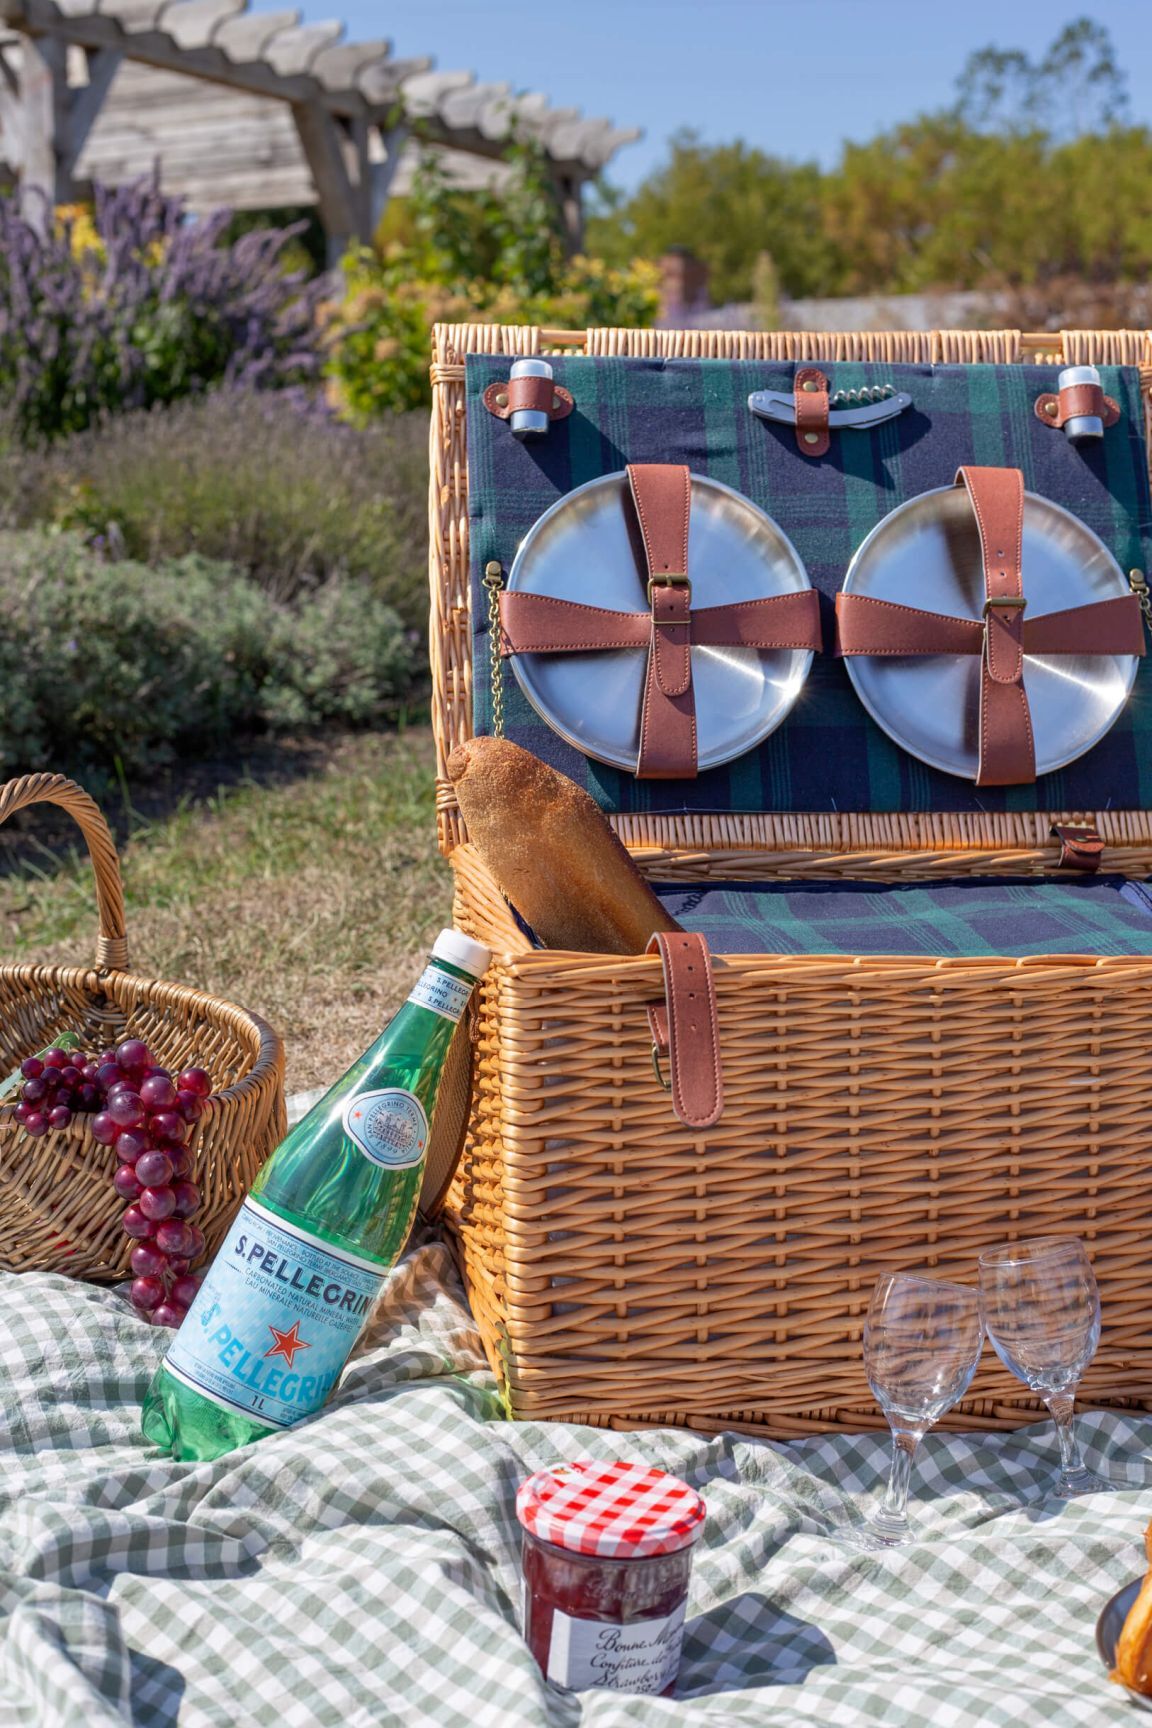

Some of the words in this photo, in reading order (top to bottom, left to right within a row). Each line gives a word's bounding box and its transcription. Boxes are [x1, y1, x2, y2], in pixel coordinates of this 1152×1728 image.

[235, 1234, 373, 1317] S.PELLEGRIN
[287, 1291, 319, 1311] NATURAL
[595, 1628, 647, 1653] Bonne
